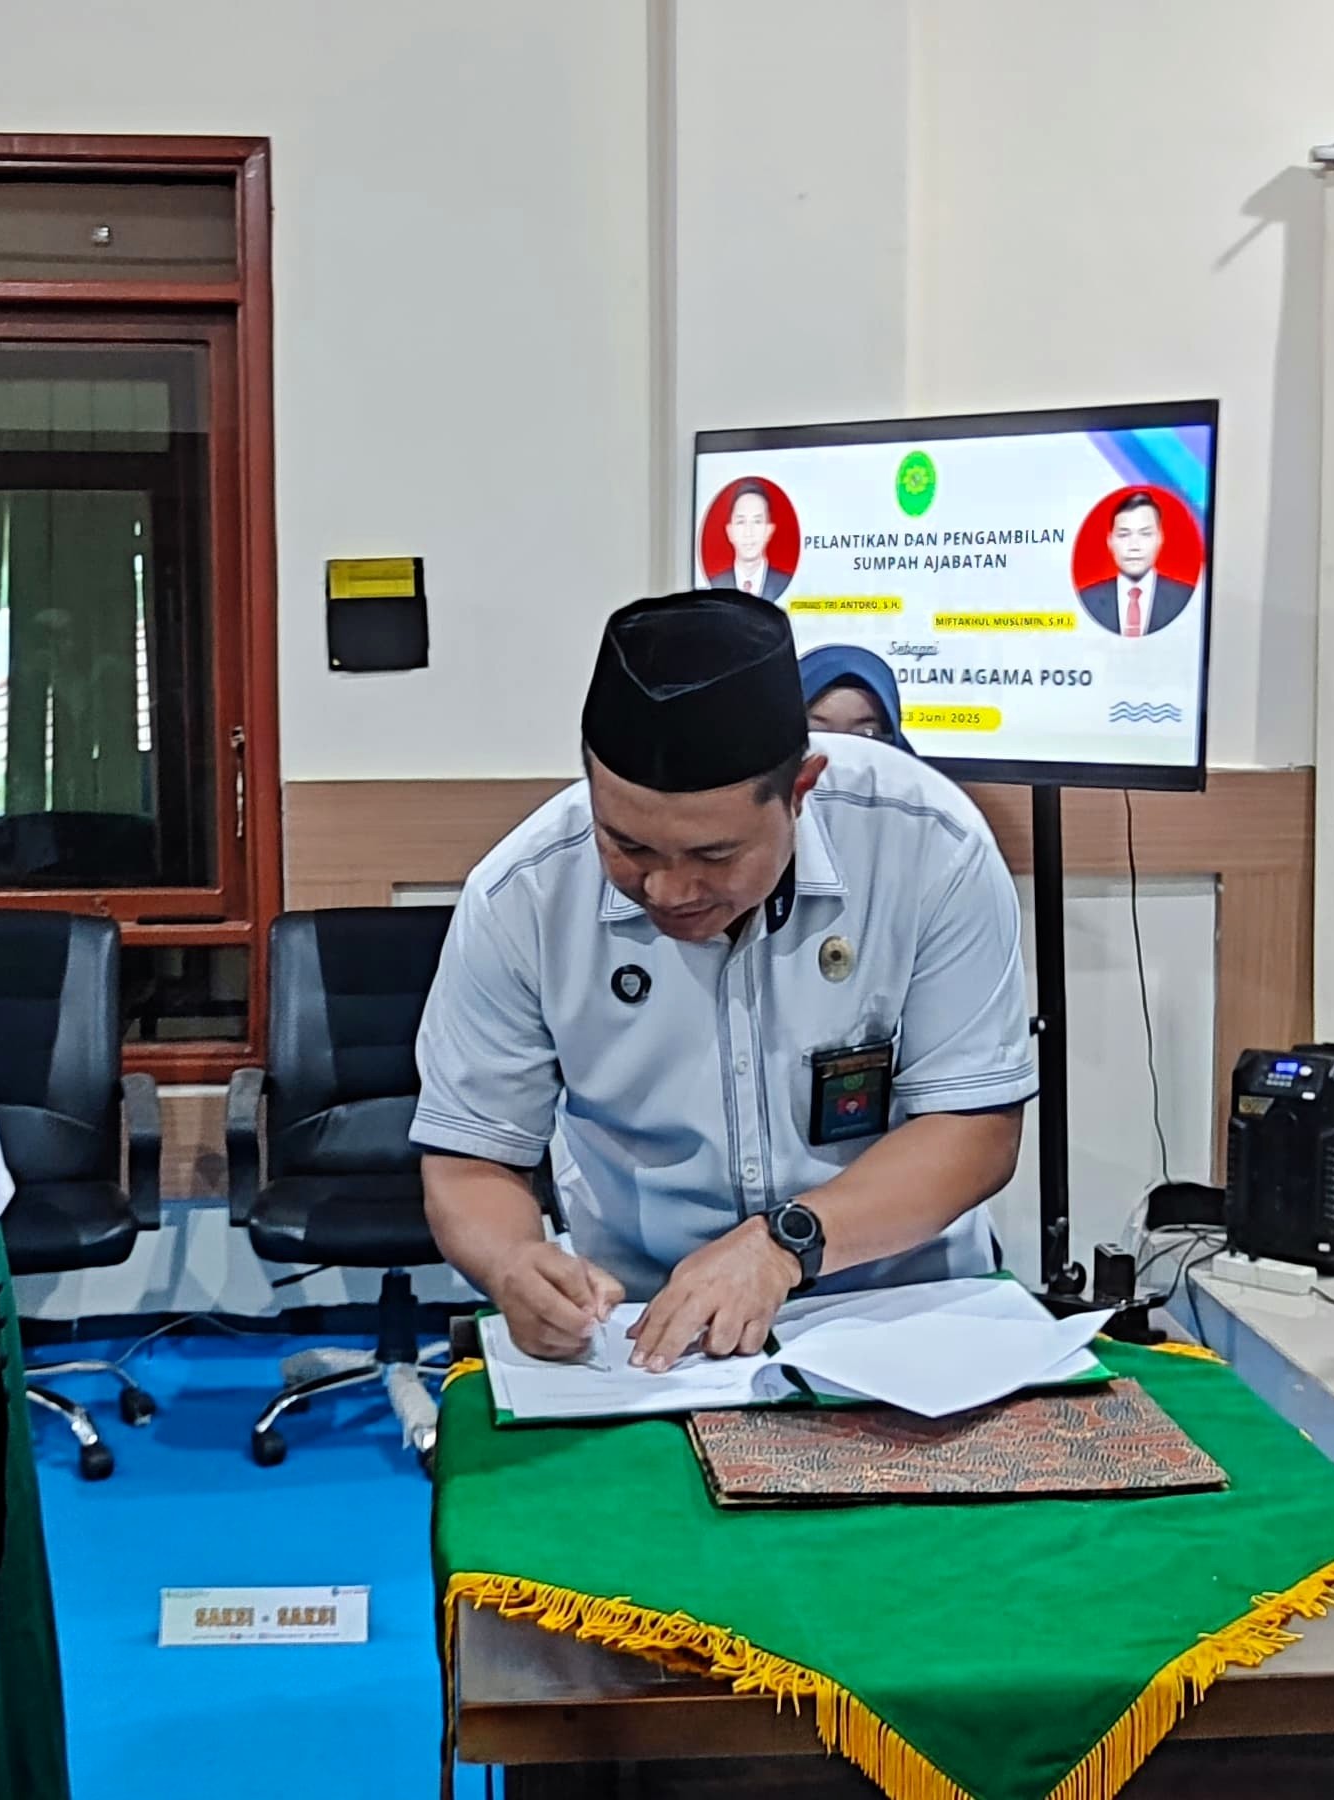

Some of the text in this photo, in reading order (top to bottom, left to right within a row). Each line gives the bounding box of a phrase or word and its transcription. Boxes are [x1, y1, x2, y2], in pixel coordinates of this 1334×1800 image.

[804, 529, 1065, 549] PELANTIKAN DAN PENGAMBILAN
[853, 553, 1007, 573] SUMPAH AJABATAN
[960, 668, 1034, 686] AGAMA
[1040, 669, 1093, 687] POSO
[918, 711, 946, 723] Juni
[950, 713, 981, 724] 2025
